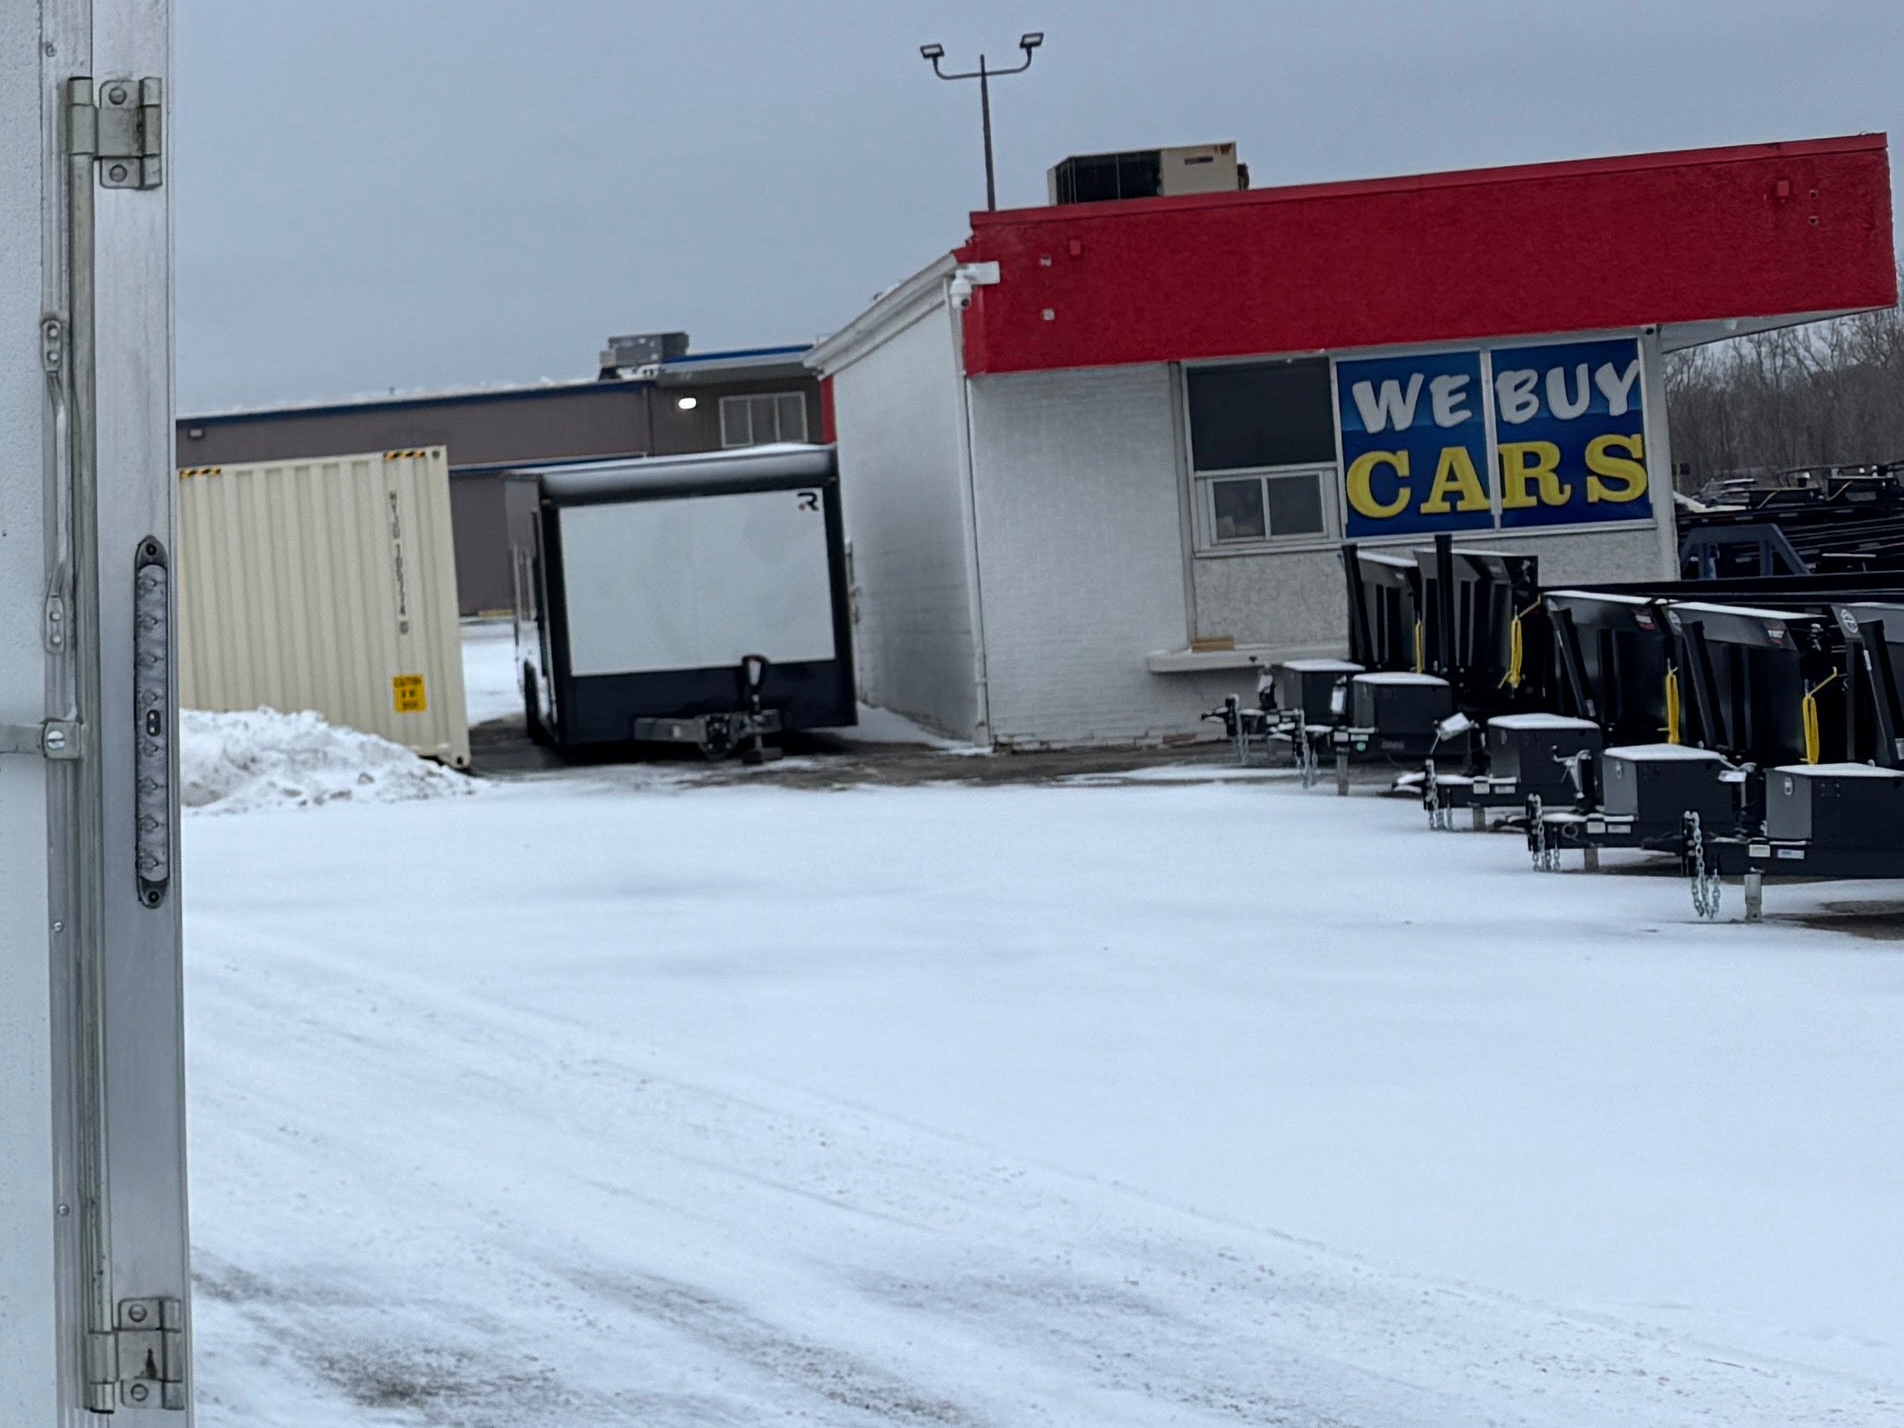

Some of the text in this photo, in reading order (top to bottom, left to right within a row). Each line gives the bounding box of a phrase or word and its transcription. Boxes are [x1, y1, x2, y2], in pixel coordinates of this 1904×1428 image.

[1352, 359, 1641, 435] WE BUY
[1345, 433, 1648, 519] CARS
